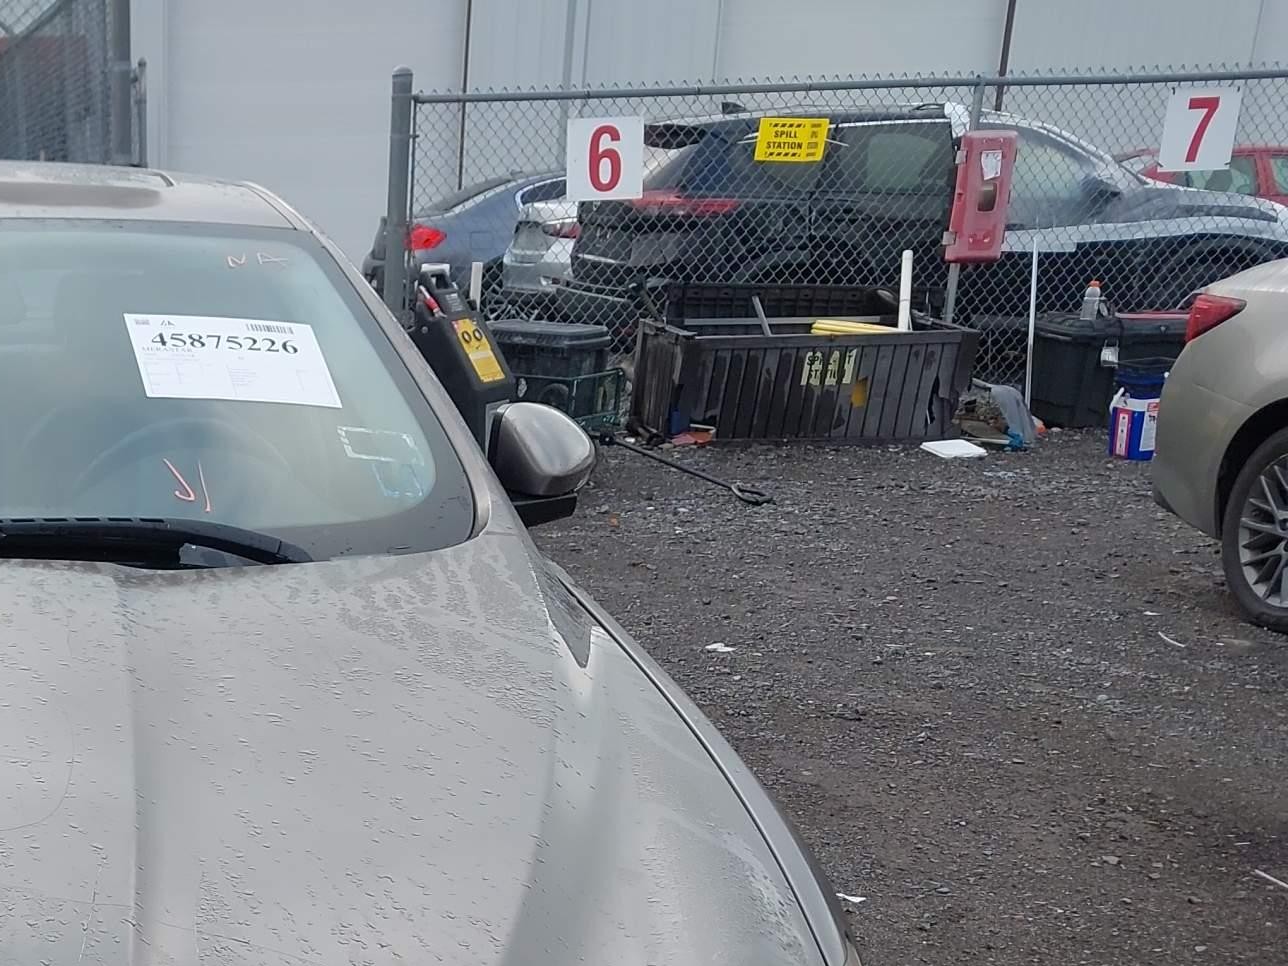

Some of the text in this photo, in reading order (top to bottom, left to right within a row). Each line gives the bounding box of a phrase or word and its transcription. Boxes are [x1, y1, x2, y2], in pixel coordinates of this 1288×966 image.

[774, 130, 798, 139] SPILL
[1185, 96, 1220, 162] 7
[766, 141, 803, 150] STATION
[589, 125, 622, 192] 6
[152, 332, 299, 355] 45875226
